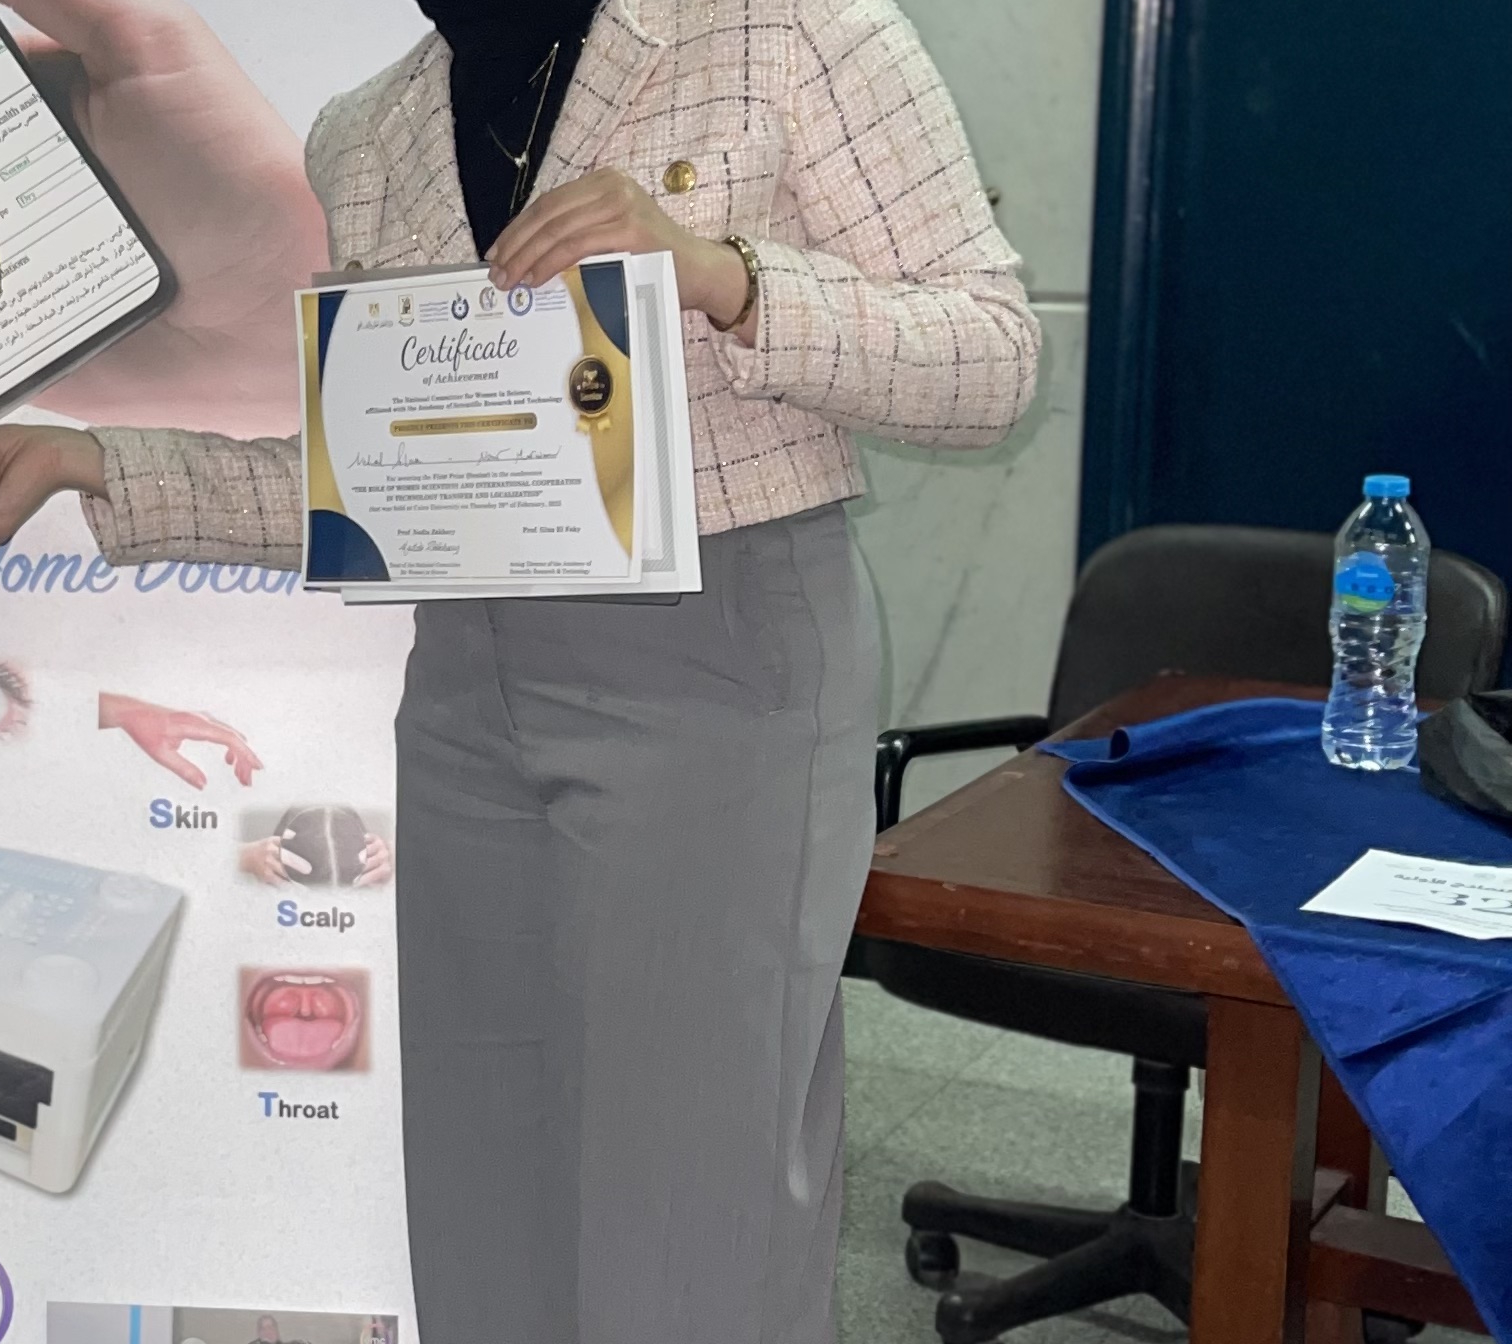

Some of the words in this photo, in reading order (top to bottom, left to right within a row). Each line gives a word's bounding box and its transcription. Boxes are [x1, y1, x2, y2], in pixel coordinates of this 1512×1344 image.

[400, 328, 520, 372] Certificate
[422, 375, 434, 387] of
[434, 370, 499, 385] Achievement
[149, 798, 218, 829] Skin
[277, 899, 356, 933] Scalp
[257, 1091, 340, 1120] Throat
